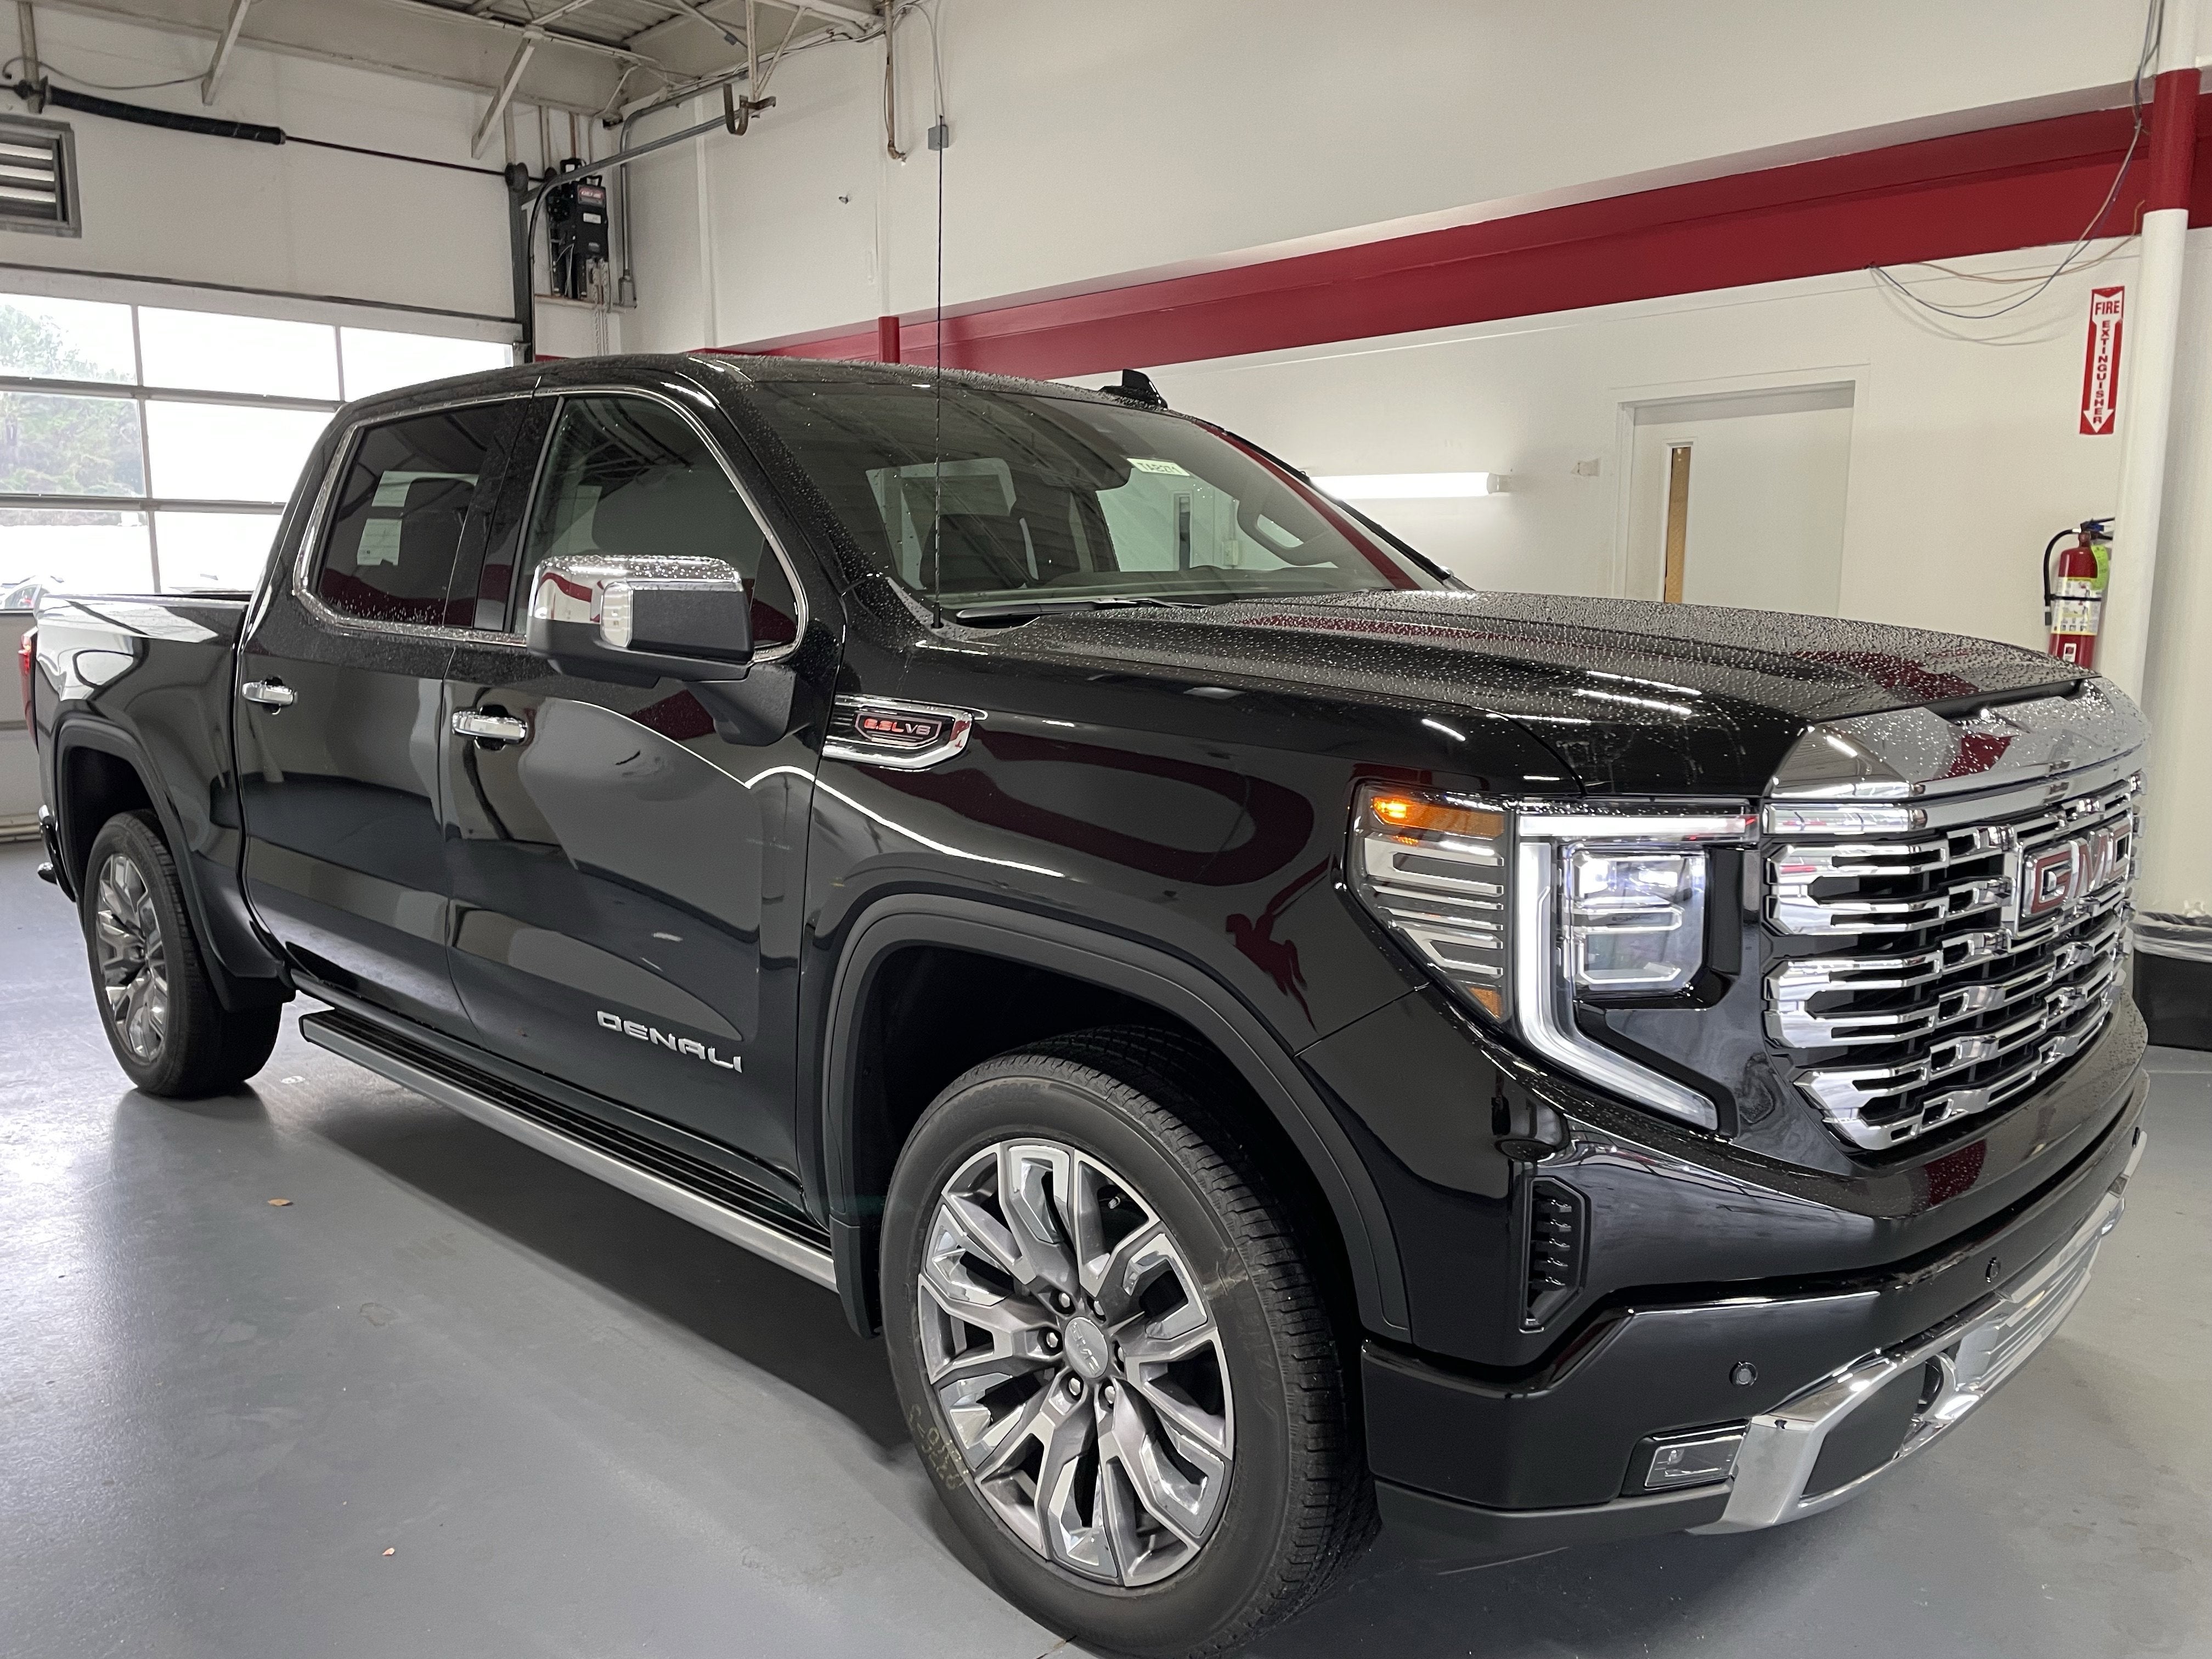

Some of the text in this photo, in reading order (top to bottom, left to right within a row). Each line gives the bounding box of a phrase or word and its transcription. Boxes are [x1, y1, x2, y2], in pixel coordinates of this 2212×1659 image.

[2095, 300, 2120, 315] FIRE
[2093, 320, 2111, 424] EXTINGUISHER
[2022, 822, 2132, 917] GMC
[596, 1010, 742, 1073] DENALI
